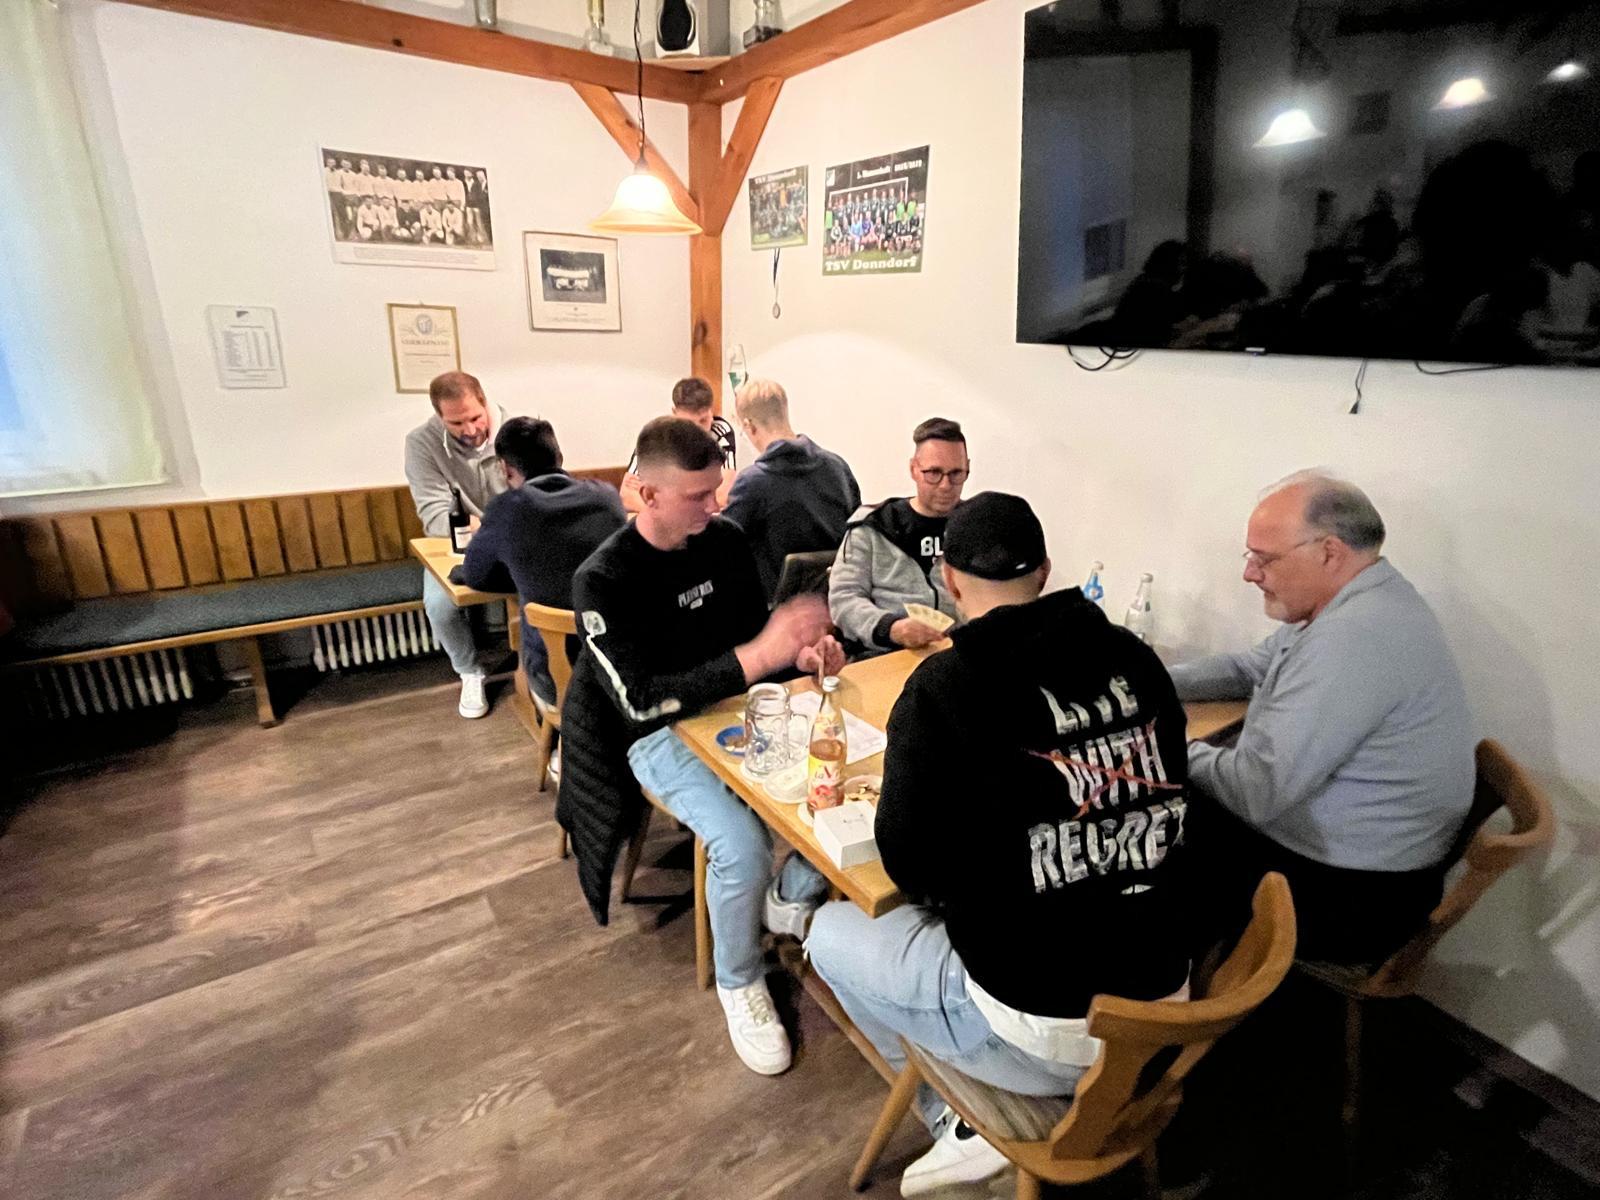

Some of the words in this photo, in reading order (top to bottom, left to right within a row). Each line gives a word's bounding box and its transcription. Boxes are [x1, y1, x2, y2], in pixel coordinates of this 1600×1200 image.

[825, 260, 850, 272] TSV
[852, 255, 918, 270] Donndorf
[1050, 725, 1169, 810] WITH
